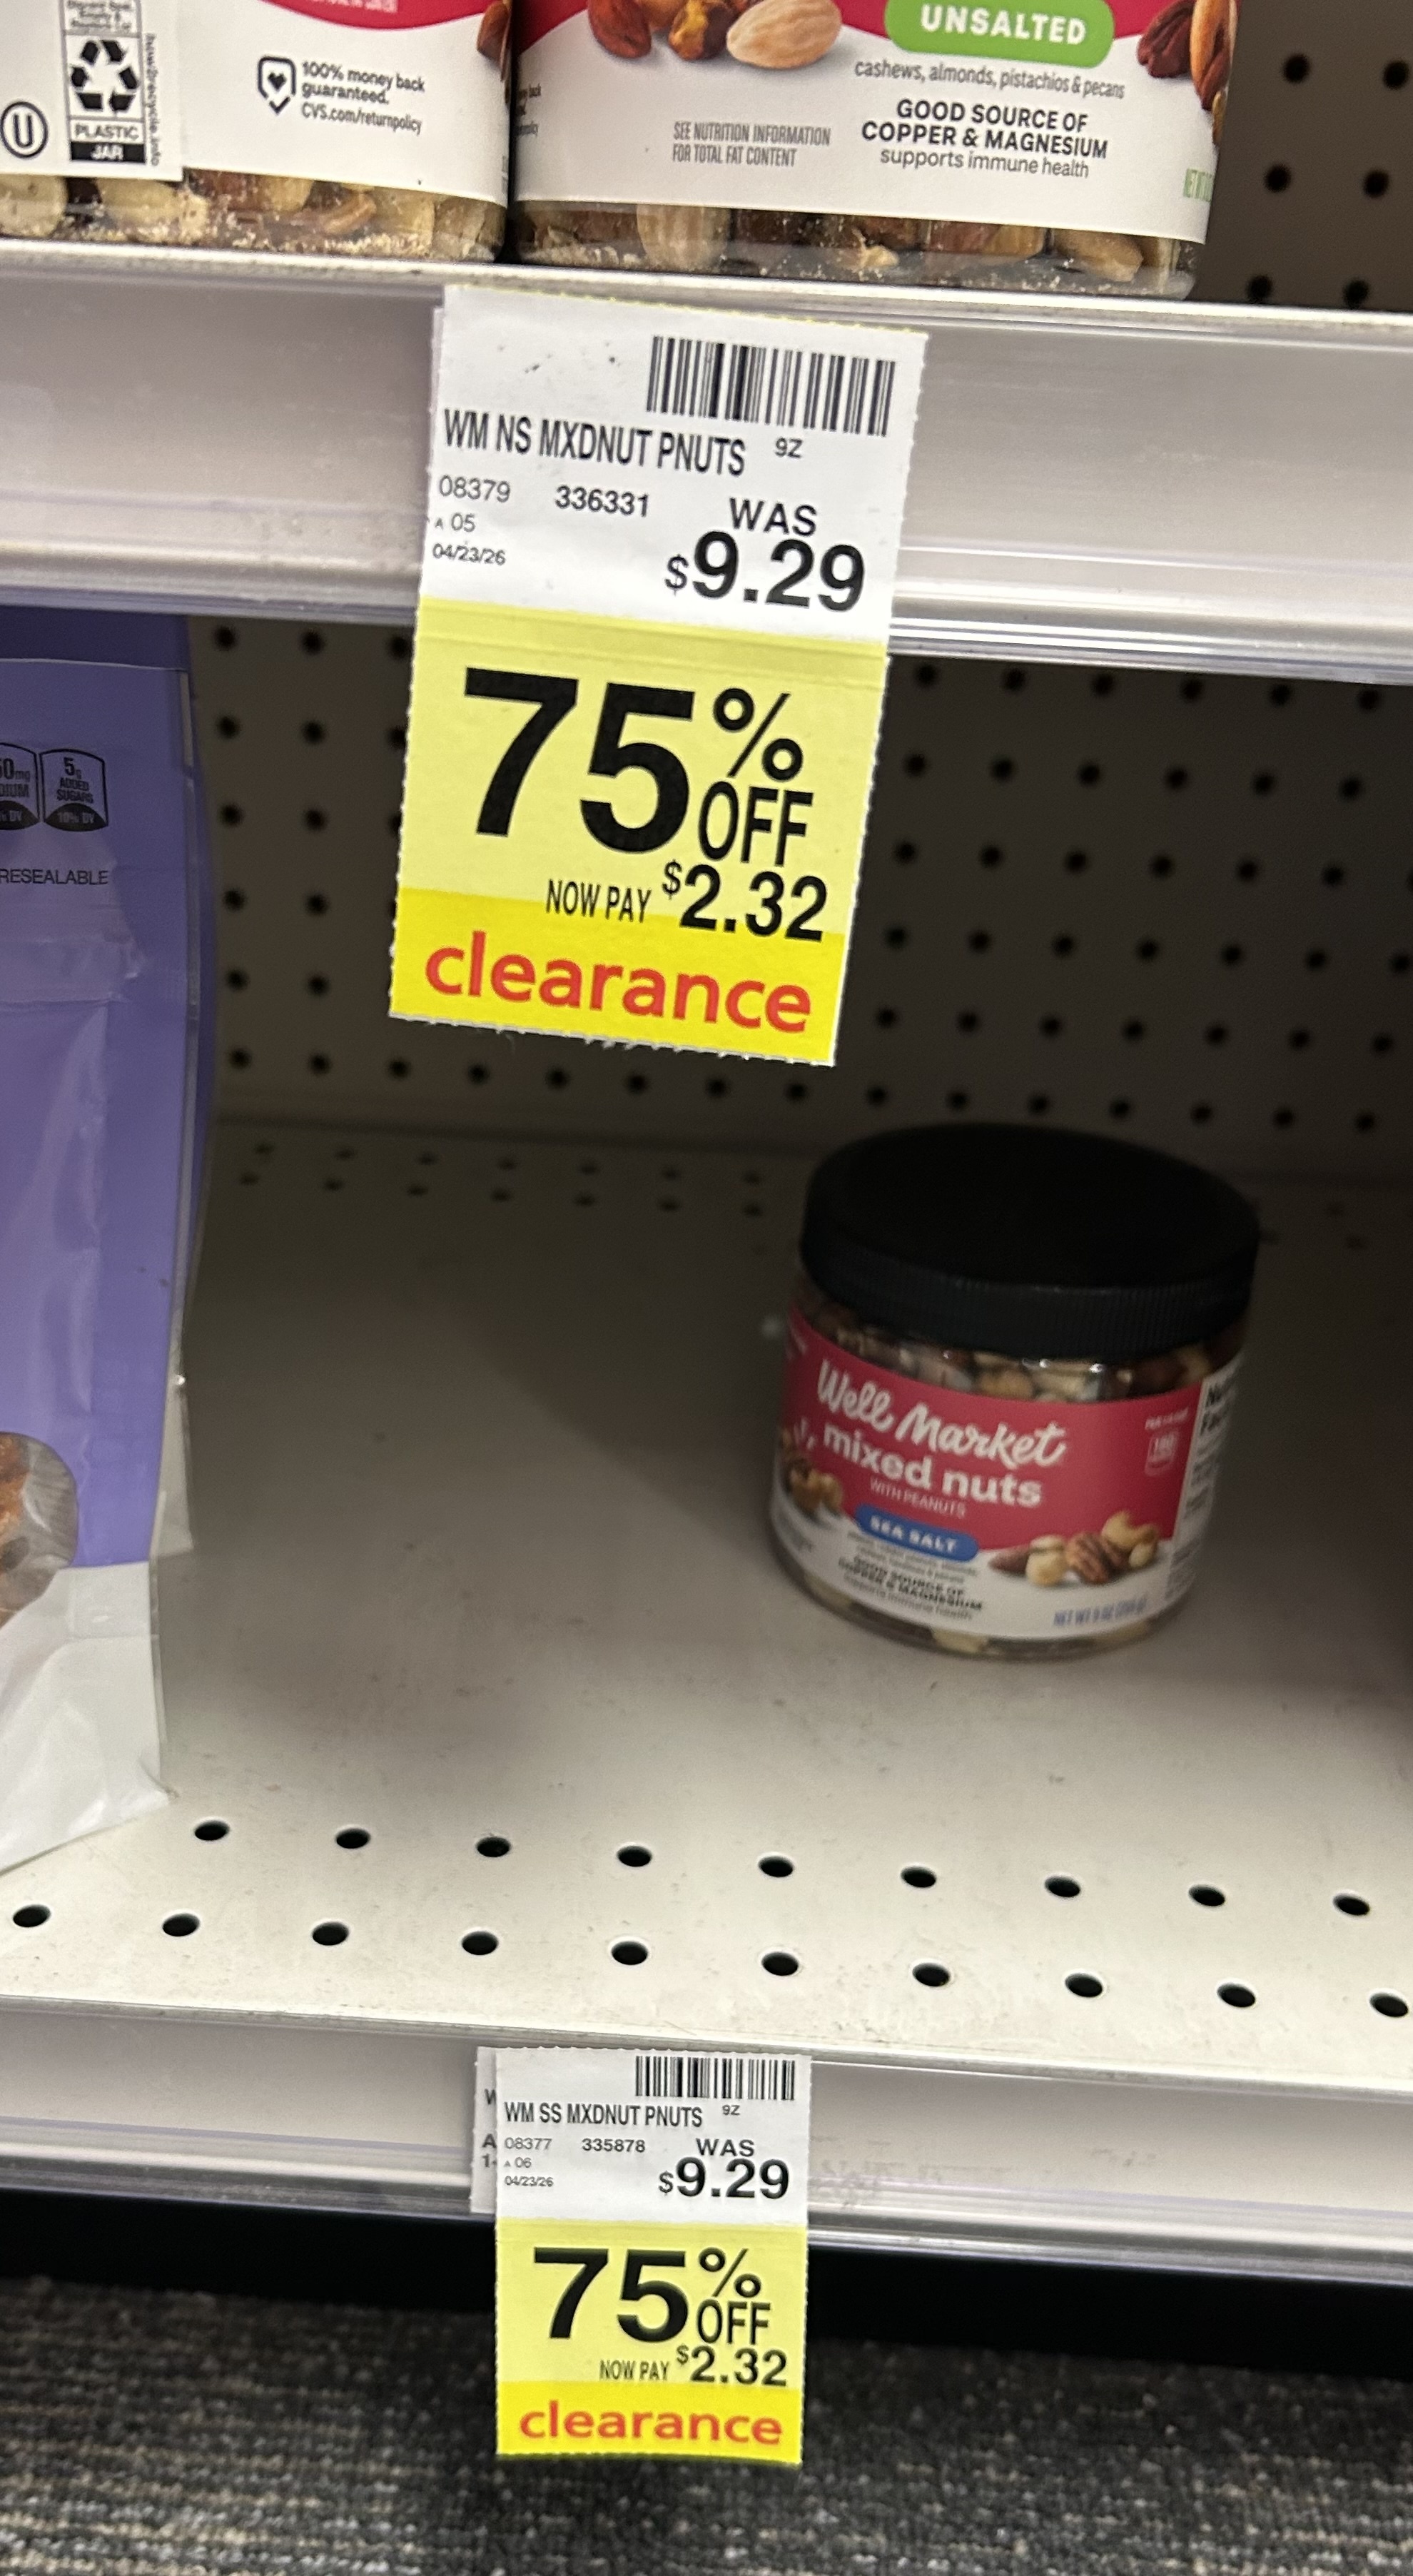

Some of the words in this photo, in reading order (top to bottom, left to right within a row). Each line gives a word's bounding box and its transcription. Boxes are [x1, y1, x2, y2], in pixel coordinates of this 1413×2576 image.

[921, 4, 1088, 46] UNSALTED
[301, 81, 390, 105] guaranteed.
[302, 61, 344, 81] 100%
[347, 69, 394, 91] money
[395, 72, 425, 92] back
[855, 59, 927, 84] cashews,
[928, 62, 998, 89] almonds,
[999, 69, 1070, 94] pistachios
[1071, 76, 1081, 93] &
[1082, 79, 1126, 99] pecans
[75, 123, 140, 141] PLASTIC
[300, 101, 422, 136] CVS.com/returnpolicy
[896, 98, 966, 122] GOOD
[971, 103, 1059, 131] SOURCE
[1062, 113, 1090, 133] OF
[674, 121, 692, 141] SEE
[693, 123, 750, 143] NUTRITION
[753, 123, 832, 146] INFORMATION
[861, 121, 957, 147] COPPER
[963, 128, 979, 148] &
[984, 129, 1109, 159] MAGNESIUM
[91, 145, 124, 161] JAR
[672, 144, 692, 163] FOR
[694, 144, 723, 165] TOTAL
[725, 146, 744, 165] FAT
[746, 146, 799, 168] CONTENT
[880, 148, 965, 170] supports
[968, 151, 1040, 174] immune
[1042, 158, 1090, 178] health
[444, 409, 488, 450] WM
[495, 415, 532, 455] NS
[539, 419, 652, 466] MXDNUT
[657, 431, 746, 477] PNUTS
[774, 437, 803, 459] 9Z
[438, 475, 511, 503] 08379
[554, 485, 650, 518] 336331
[450, 513, 476, 533] 05
[730, 497, 819, 537] WAS
[432, 542, 507, 567] 04/23/26
[664, 530, 866, 613] $9.29
[0, 782, 29, 798] DIUM
[56, 789, 93, 804] SUGARS
[60, 777, 90, 791] ADDED
[699, 781, 814, 868] OFF
[0, 868, 108, 885] RESEALABLE
[545, 879, 600, 919] NOW
[605, 886, 651, 924] PAY
[662, 861, 828, 942] $2.32
[425, 930, 812, 1034] clearance
[816, 1358, 895, 1430] Well
[894, 1403, 1068, 1469] Market
[823, 1422, 933, 1490] mixed
[942, 1468, 1043, 1509] nuts
[869, 1478, 901, 1500] WITH
[903, 1490, 967, 1519] PEANUTS
[870, 1515, 904, 1540] SEA
[909, 1529, 958, 1554] SALT
[504, 2101, 535, 2123] WM
[539, 2103, 562, 2123] SS
[567, 2103, 640, 2126] MXDNUT
[644, 2106, 704, 2128] PNUTS
[722, 2105, 740, 2116] 9Z
[504, 2137, 552, 2151] 08377
[582, 2138, 646, 2153] 335878
[697, 2138, 755, 2157] WAS
[515, 2158, 532, 2168] 06
[659, 2156, 789, 2199] $9.29
[505, 2176, 554, 2187] 04/23/26
[696, 2298, 771, 2345] OFF
[599, 2360, 637, 2380] NOW
[641, 2362, 669, 2380] PAY
[676, 2344, 788, 2387] $2.32
[520, 2400, 783, 2445] clearance
